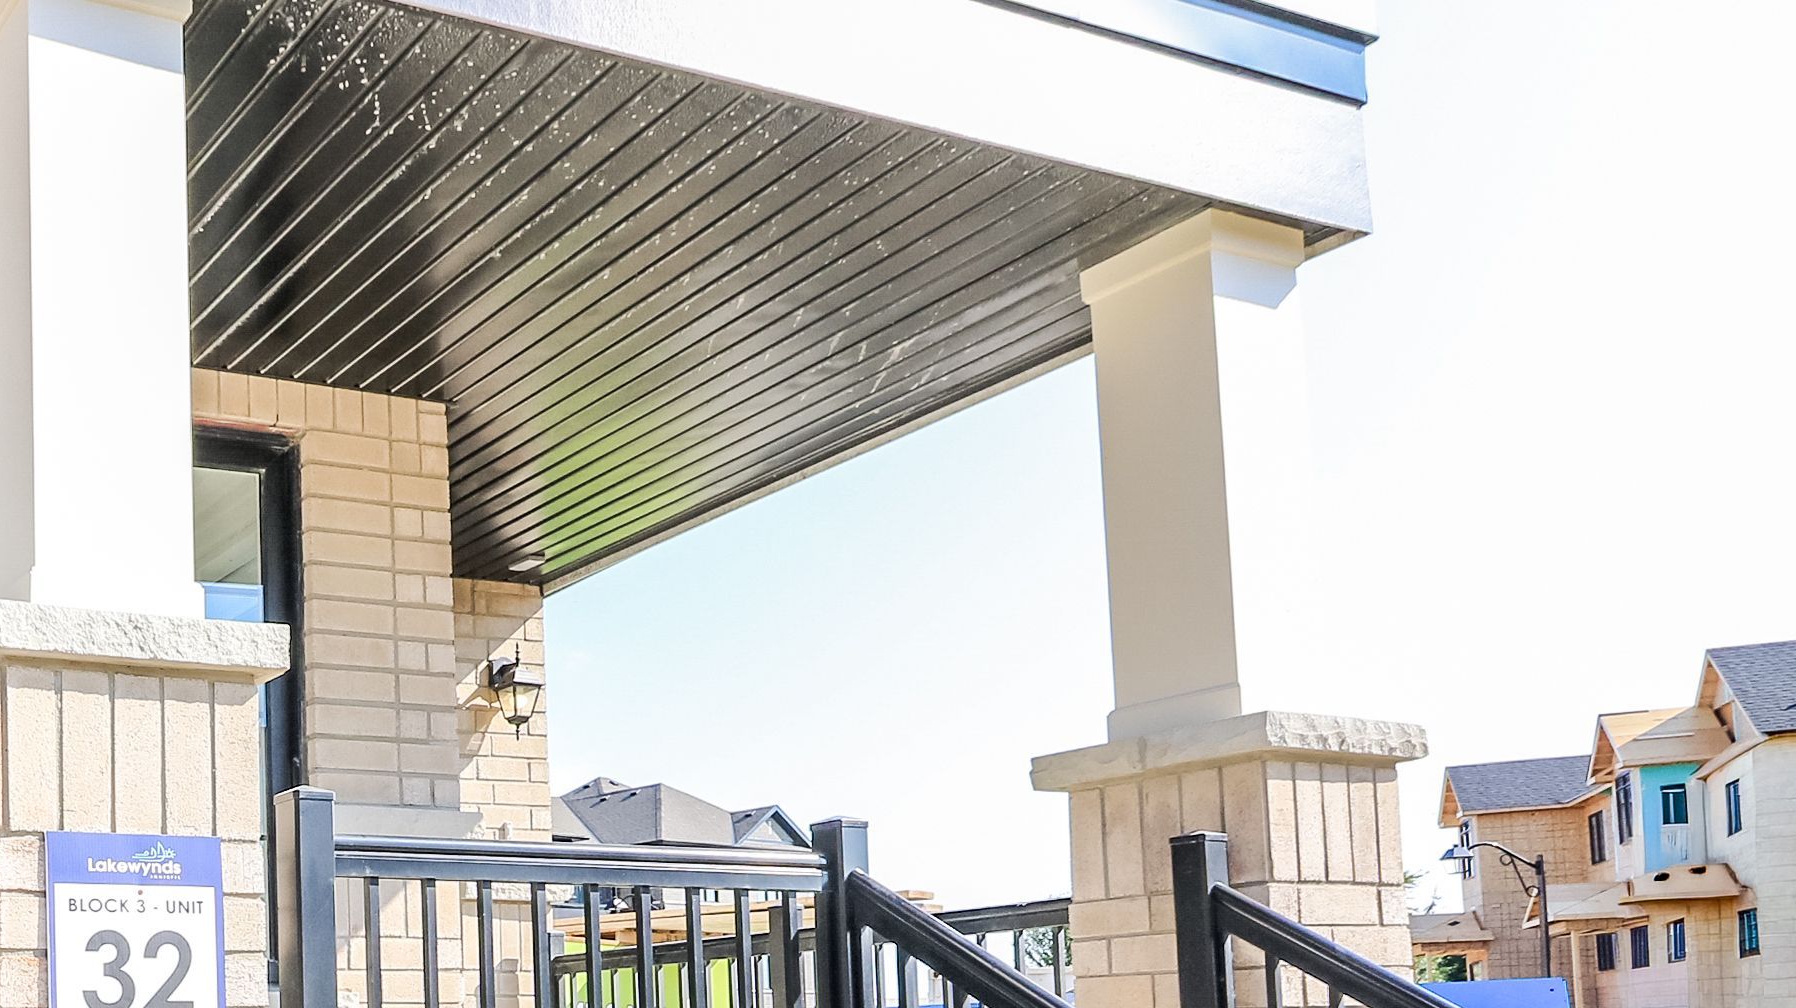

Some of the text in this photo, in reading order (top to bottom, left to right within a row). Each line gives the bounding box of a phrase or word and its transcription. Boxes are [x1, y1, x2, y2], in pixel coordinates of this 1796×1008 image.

[87, 857, 182, 877] Lakewynds
[68, 898, 130, 913] BLOCK
[136, 899, 146, 913] 3
[166, 900, 204, 914] UNIT
